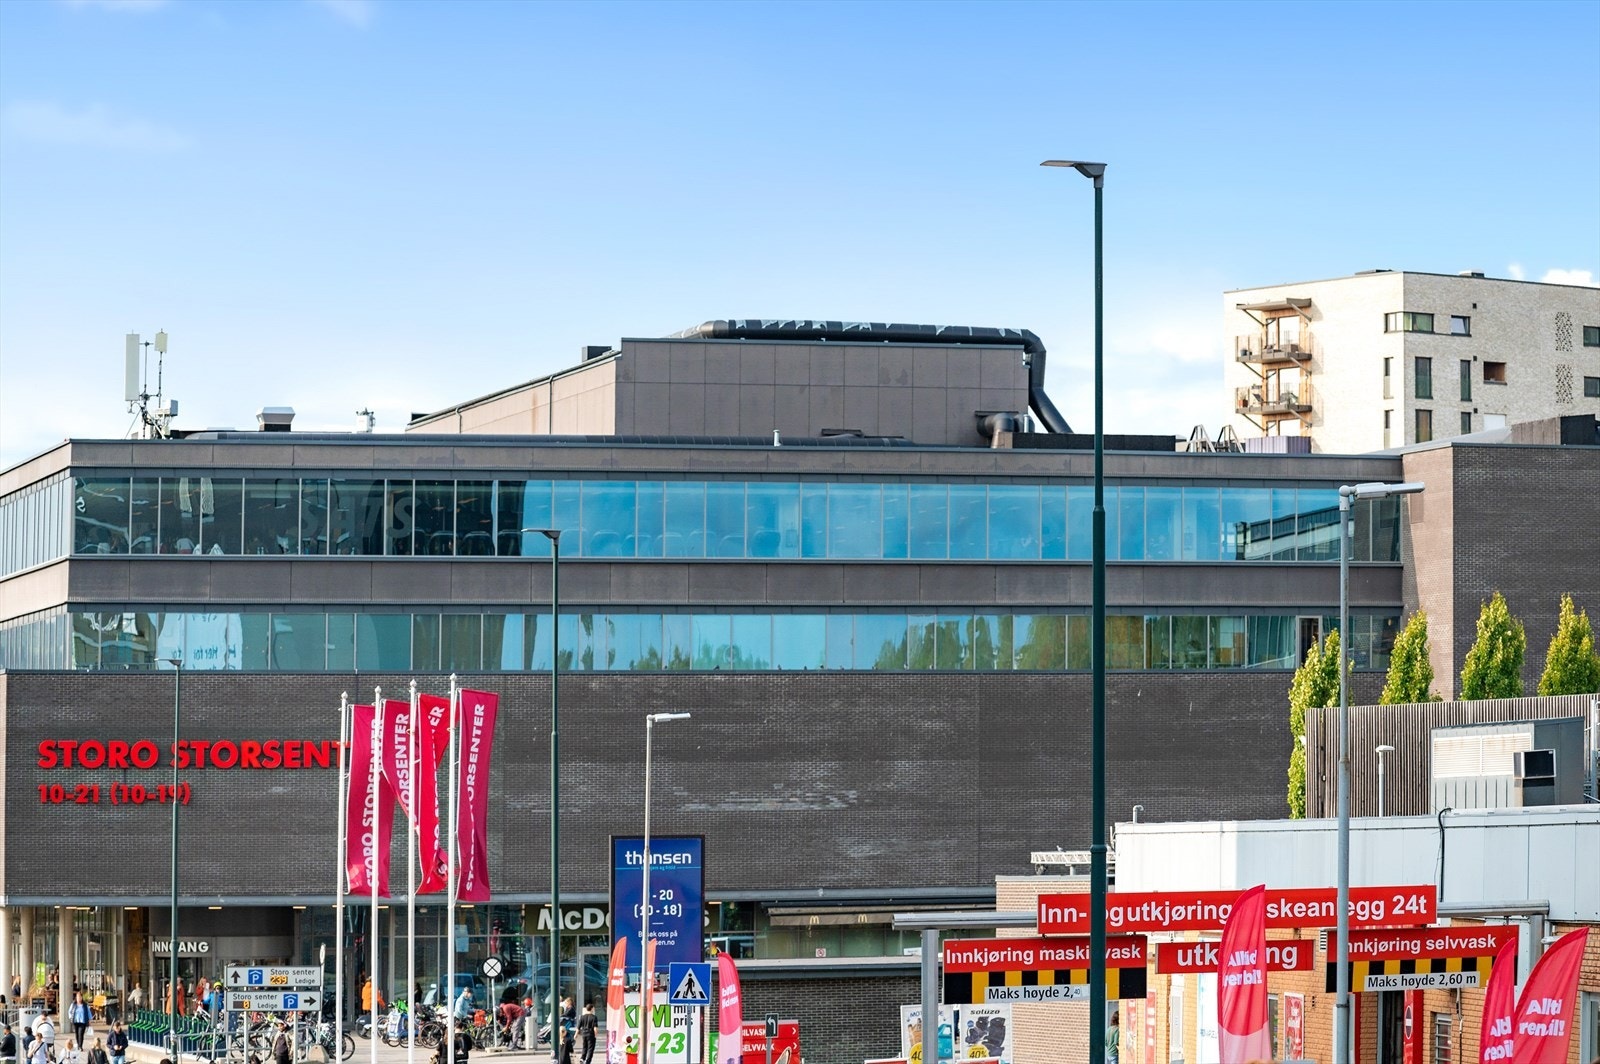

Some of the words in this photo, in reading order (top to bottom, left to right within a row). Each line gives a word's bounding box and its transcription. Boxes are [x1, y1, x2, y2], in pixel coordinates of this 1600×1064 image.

[37, 739, 159, 769] STORO
[465, 703, 485, 818] ORSENTER
[394, 713, 417, 822] ORSENTER
[37, 784, 100, 804] 10-21
[110, 781, 191, 805] (10-19)
[1041, 903, 1087, 924] Inn-
[1127, 900, 1233, 926] utkjøring
[1266, 898, 1385, 921] skeanegg
[1392, 894, 1428, 915] 24t
[946, 948, 1034, 967] Innkjøring
[1039, 944, 1142, 961] maskivask
[1347, 937, 1421, 955] nnkjøring
[1426, 934, 1496, 950] selvvask
[1177, 943, 1298, 970] utkng
[270, 968, 290, 976] Storo
[1368, 976, 1398, 988] Maks
[1401, 974, 1435, 989] høyde
[1439, 973, 1463, 987] 2,60
[1466, 974, 1477, 984] m
[988, 987, 1020, 1000] Maks
[1023, 986, 1059, 1001] høyde
[674, 1005, 696, 1013] mii
